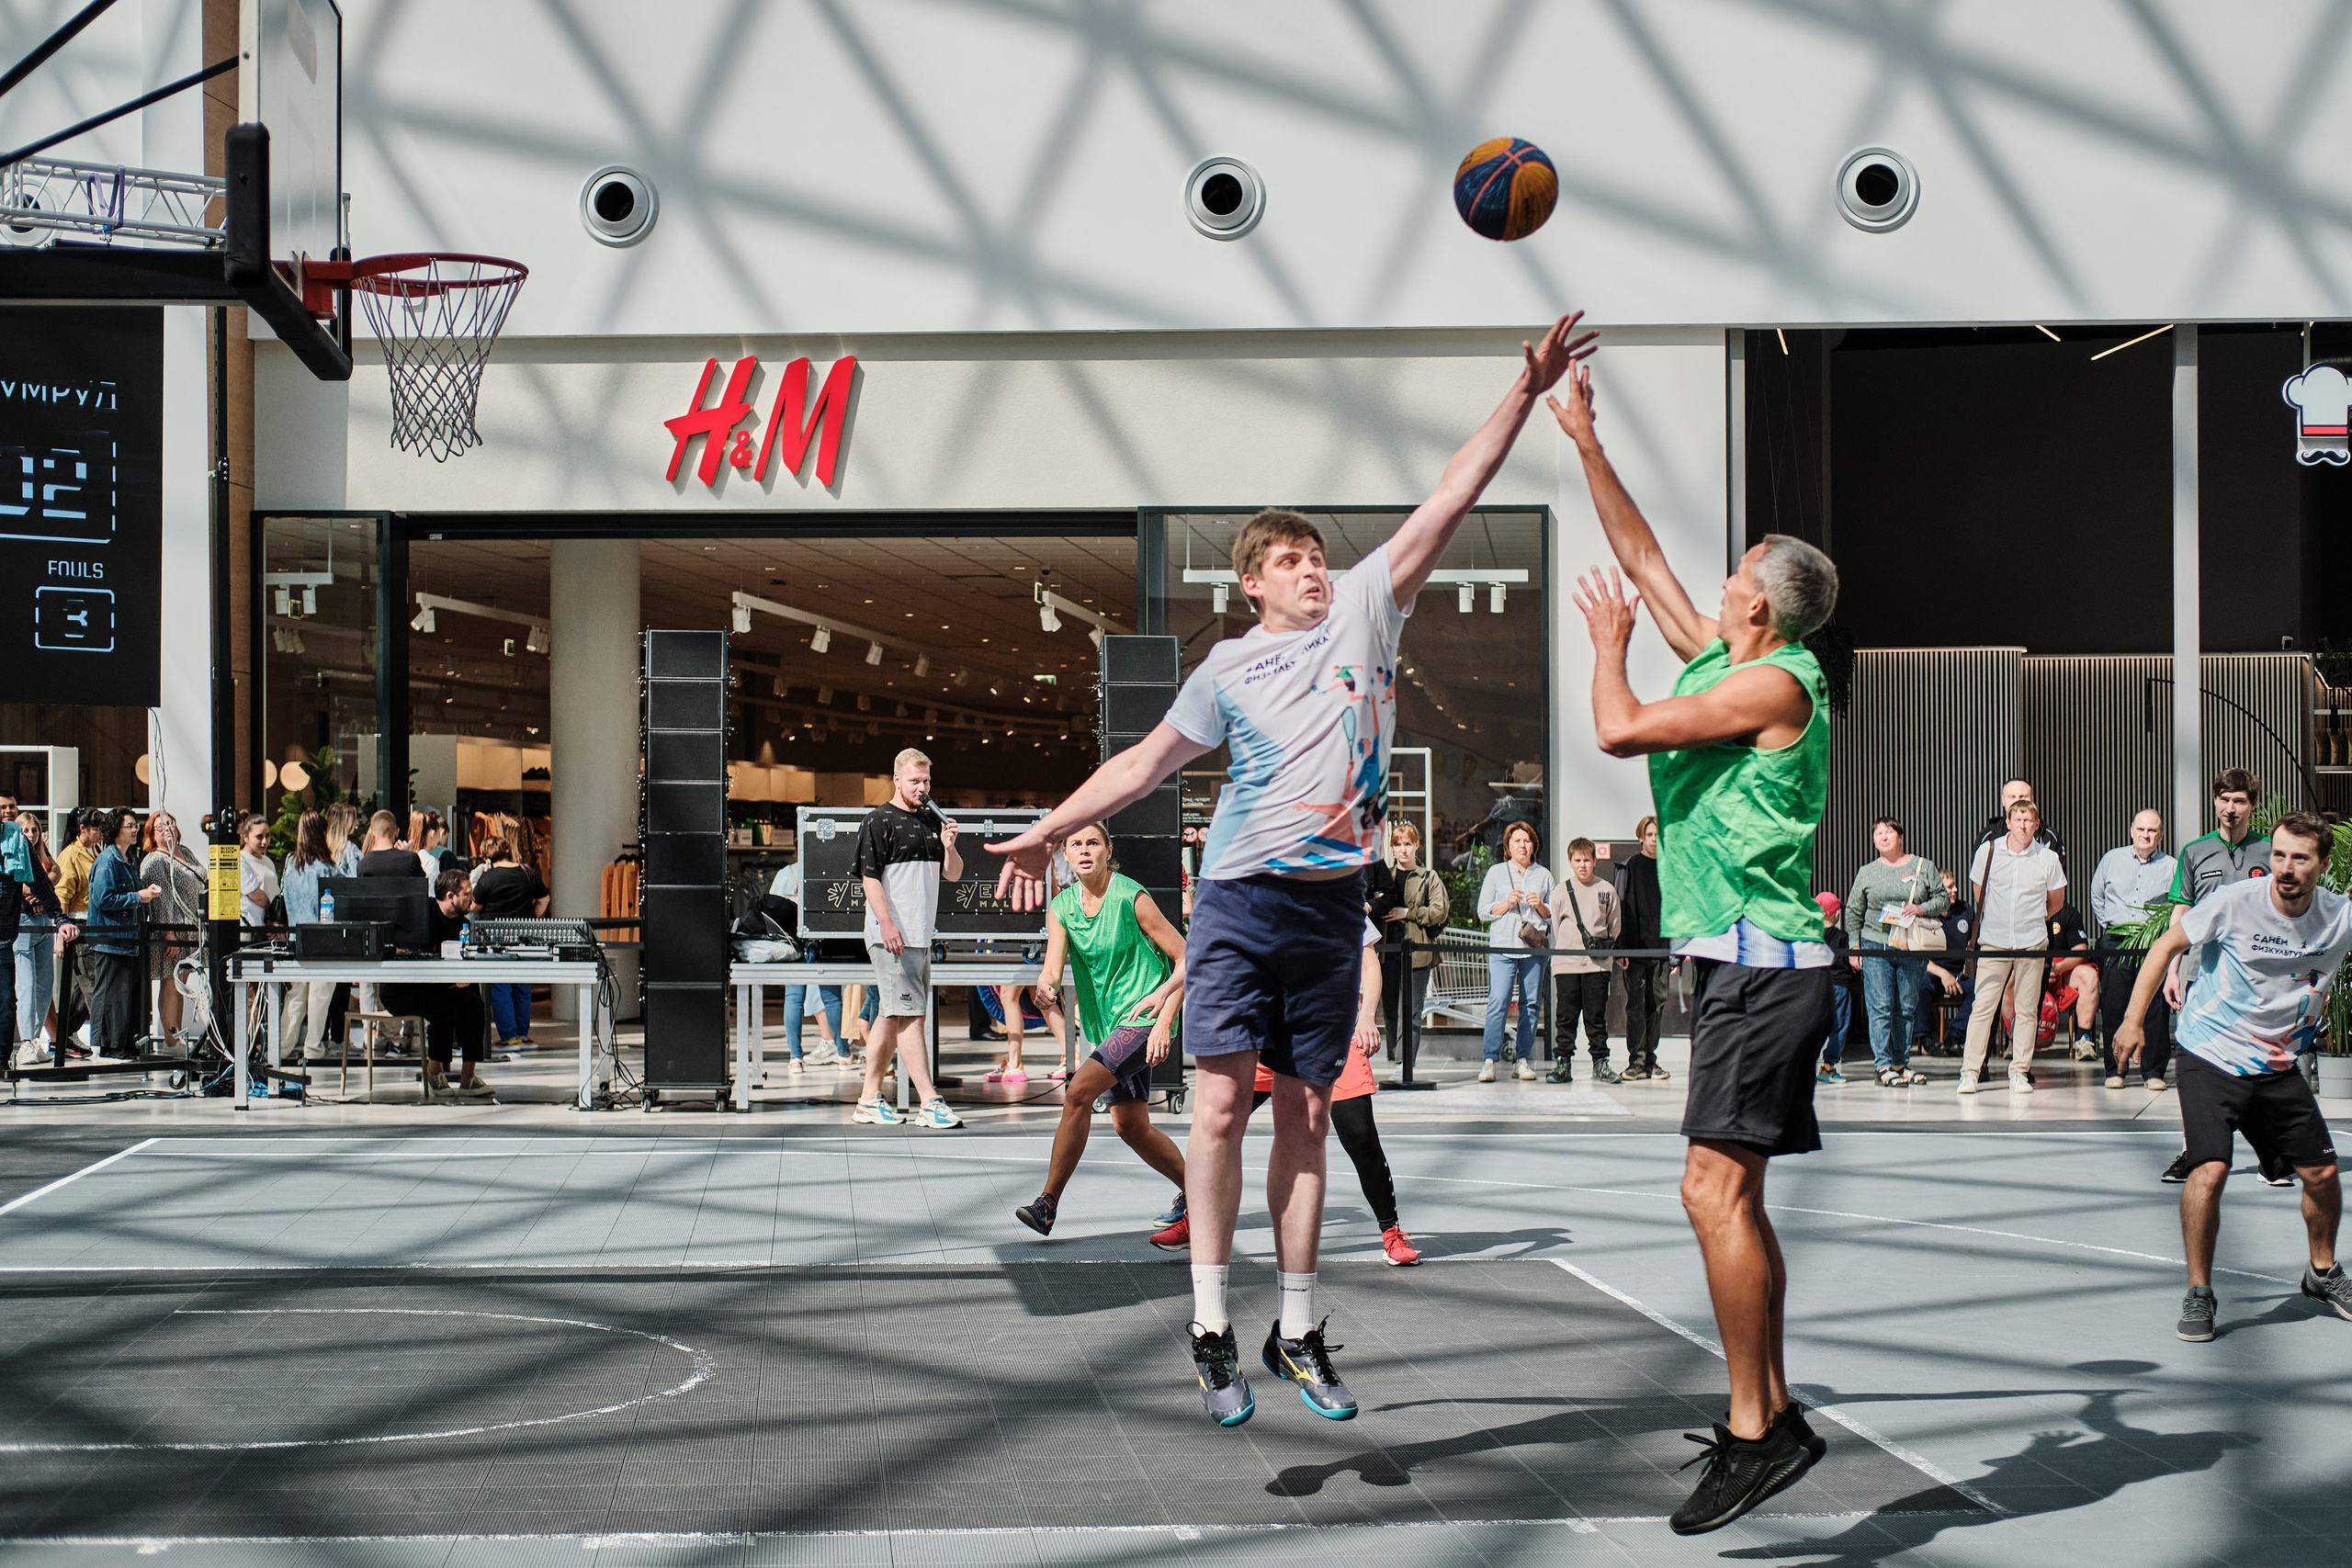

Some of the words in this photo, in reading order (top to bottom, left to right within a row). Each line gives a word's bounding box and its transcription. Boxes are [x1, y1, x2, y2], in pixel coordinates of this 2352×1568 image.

[663, 355, 856, 487] H&M
[48, 559, 104, 579] FOULS
[1255, 653, 1285, 671] ДНЁ
[827, 883, 864, 908] YE
[2260, 936, 2289, 946] ДНЁМ
